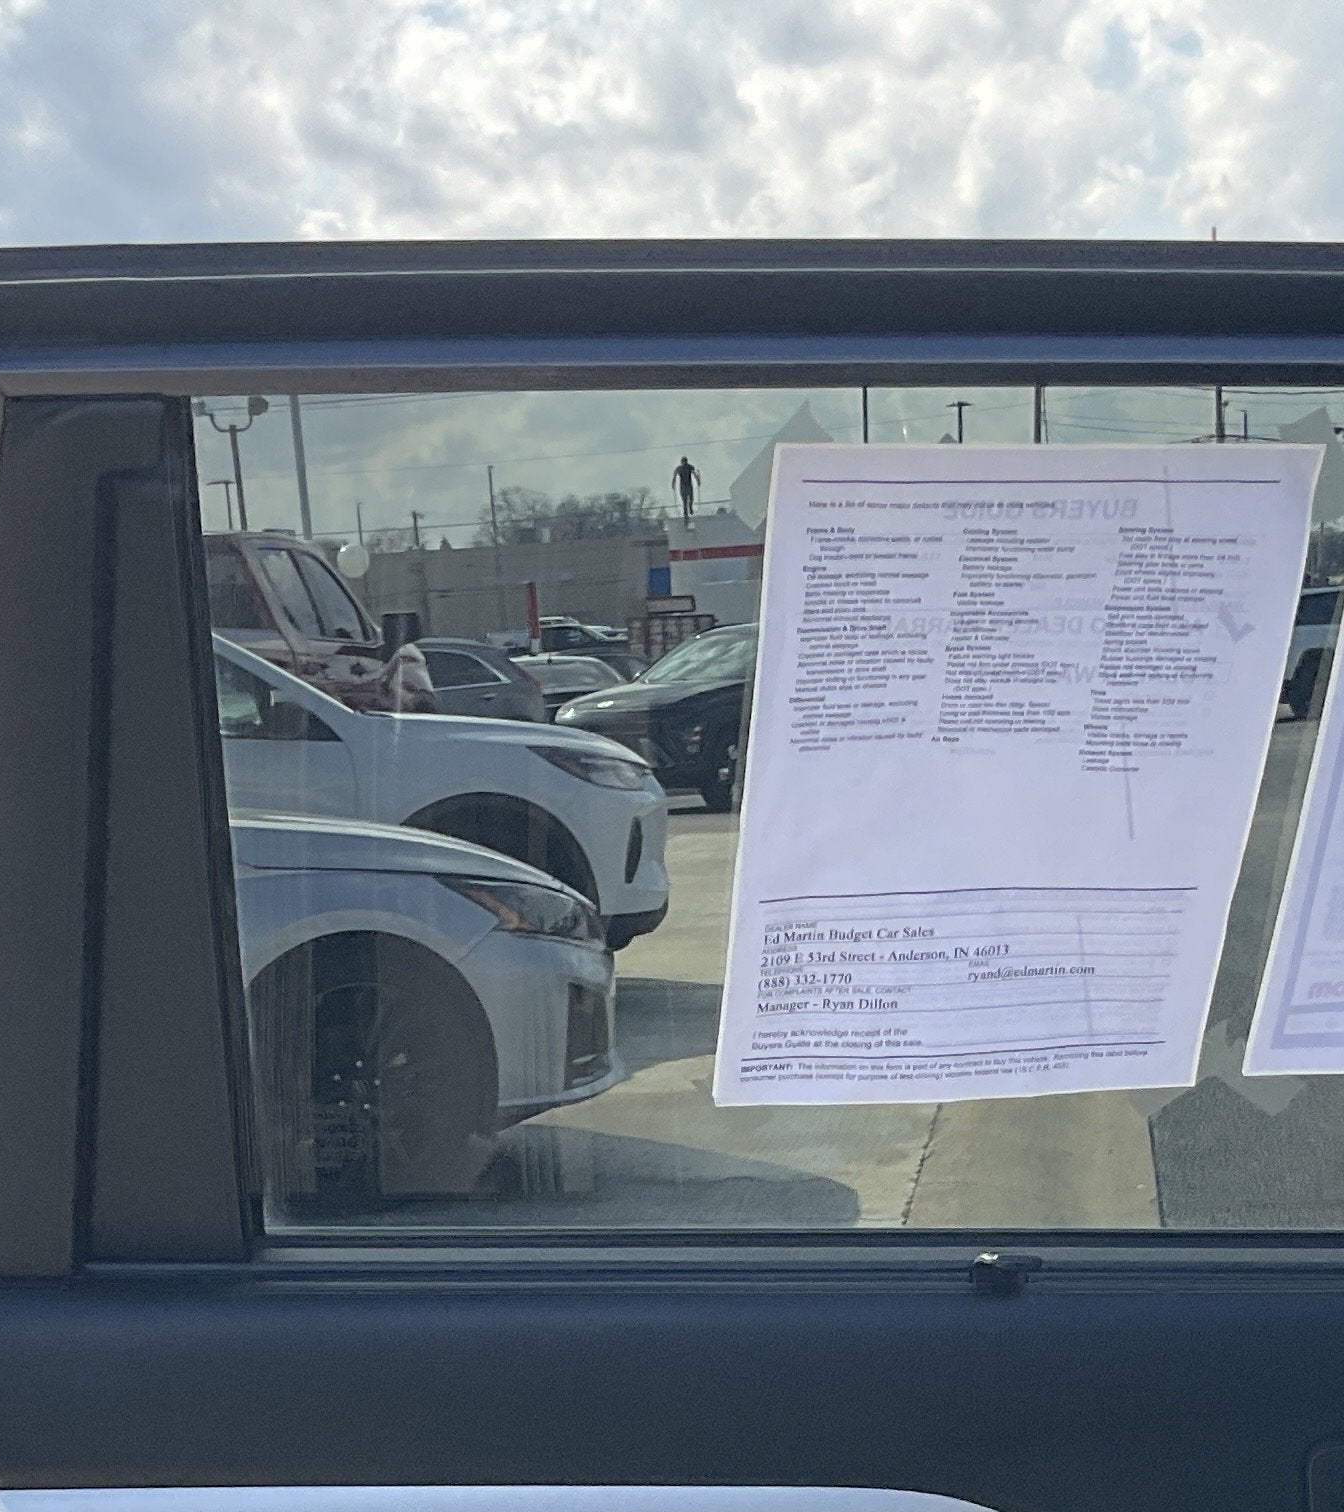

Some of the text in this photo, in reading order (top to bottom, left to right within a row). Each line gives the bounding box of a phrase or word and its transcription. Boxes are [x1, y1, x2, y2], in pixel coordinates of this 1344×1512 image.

[837, 527, 855, 535] Body
[764, 926, 935, 946] Ed Martin Budget Car Sales
[761, 956, 791, 968] 2109
[807, 952, 835, 963] 53rd
[839, 952, 876, 963] Street
[888, 950, 950, 962] Anderson,
[954, 947, 969, 958] IN
[973, 944, 1010, 957] 46013
[758, 973, 852, 991] (888) 332-1770
[968, 966, 1095, 983] ryand@edmartin.com
[757, 1001, 810, 1015] Manager
[822, 999, 854, 1012] Ryan
[858, 998, 898, 1010] Dillon
[758, 1031, 788, 1039] hereby
[791, 1029, 849, 1038] acknowledge
[882, 1028, 892, 1036] of
[893, 1028, 908, 1036] the
